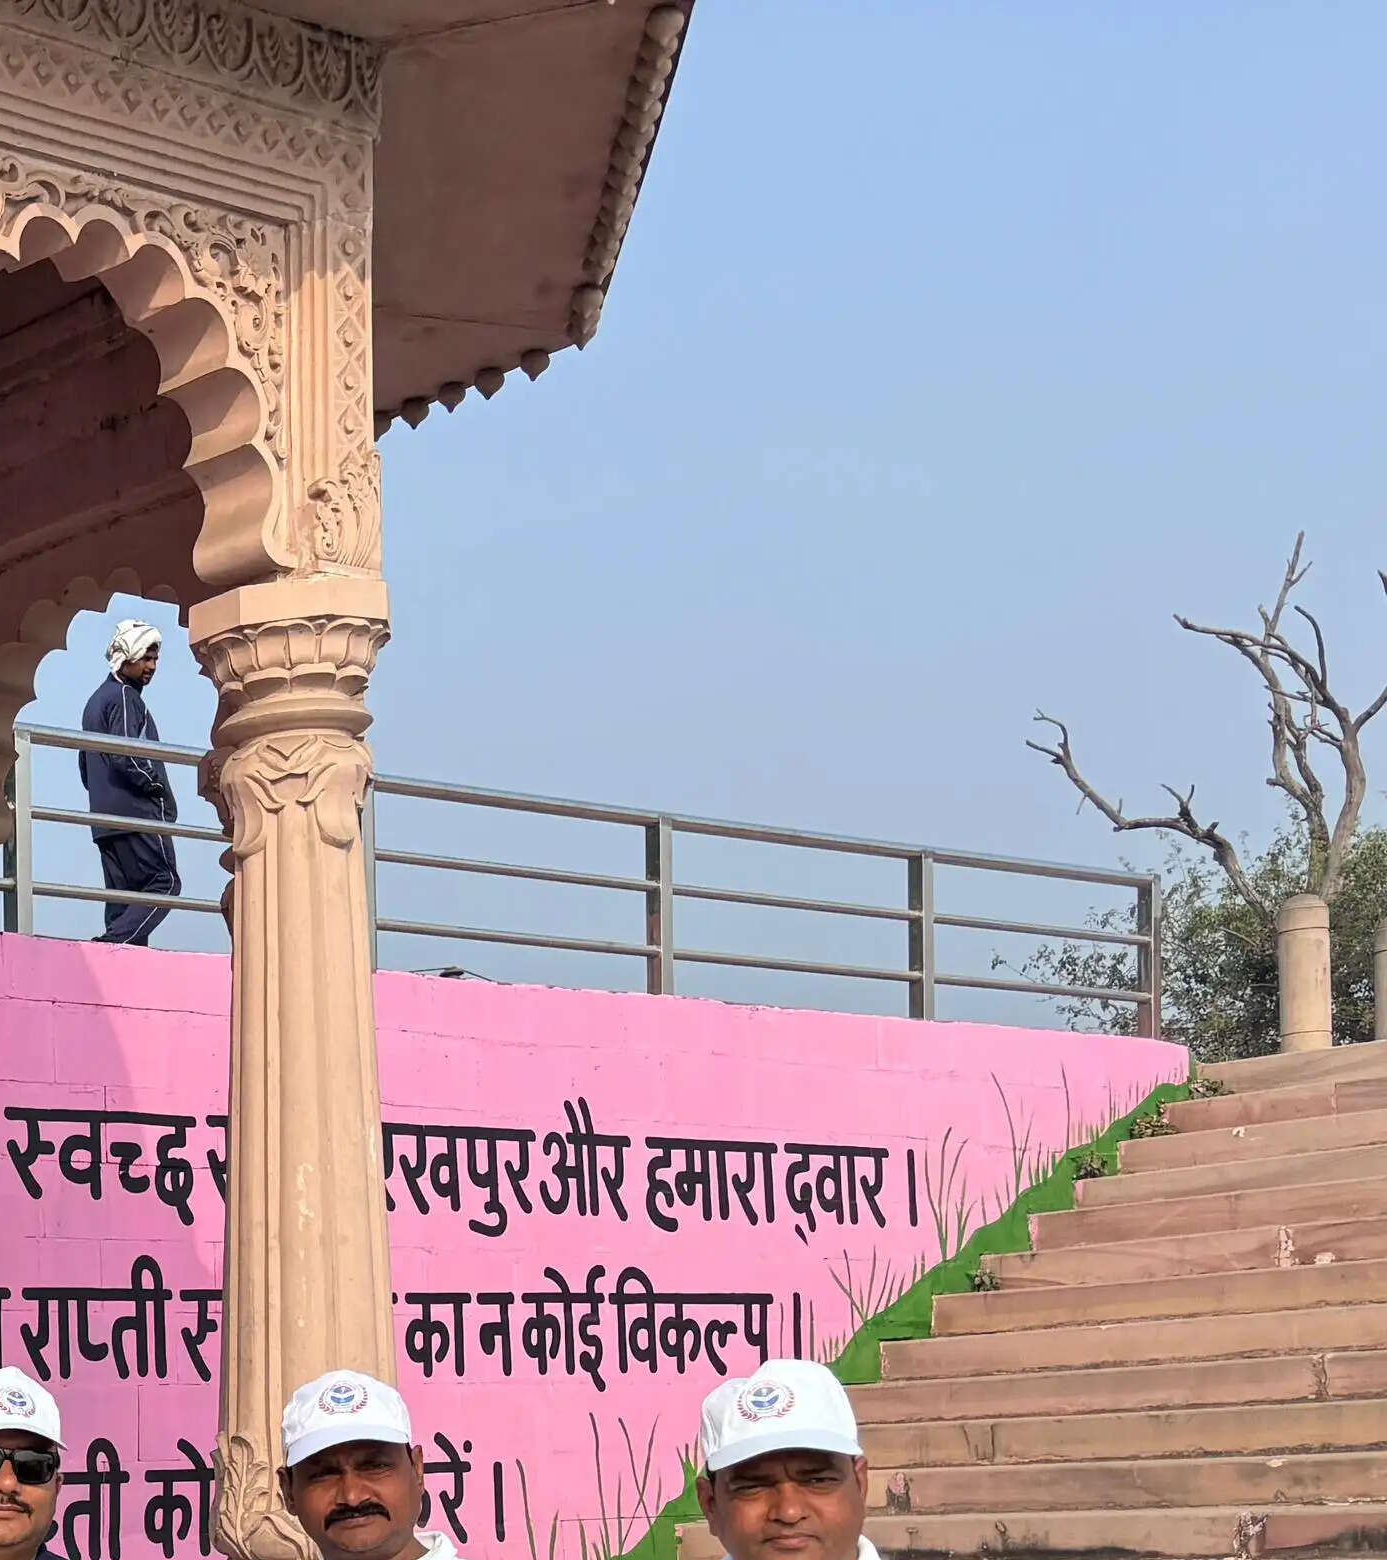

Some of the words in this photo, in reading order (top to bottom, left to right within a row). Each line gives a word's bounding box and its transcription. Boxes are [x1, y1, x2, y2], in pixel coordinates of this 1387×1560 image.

[539, 1096, 631, 1222] और
[645, 1136, 778, 1232] हमारा
[22, 1255, 173, 1382] राप्ती
[404, 1291, 471, 1378] का
[478, 1291, 516, 1376] न
[522, 1264, 607, 1393] कोई
[608, 1266, 773, 1377] विकल्प
